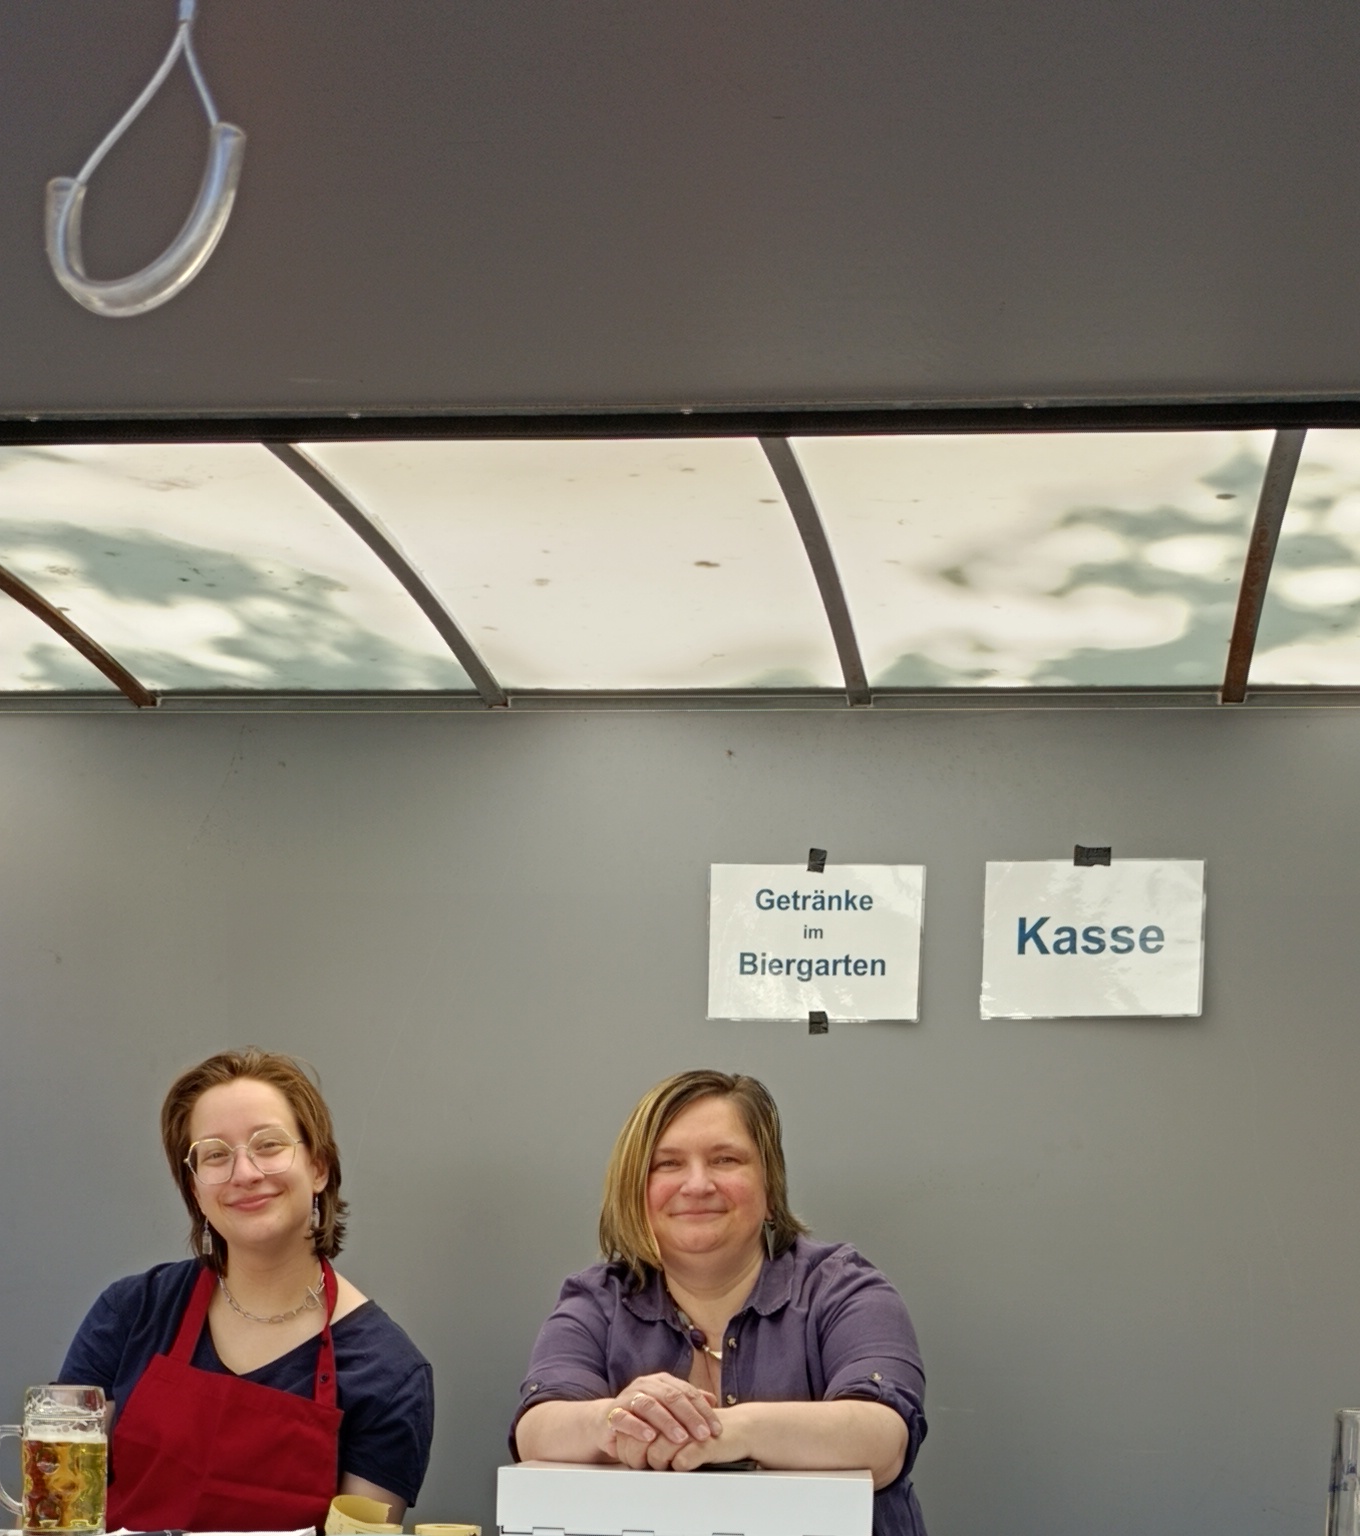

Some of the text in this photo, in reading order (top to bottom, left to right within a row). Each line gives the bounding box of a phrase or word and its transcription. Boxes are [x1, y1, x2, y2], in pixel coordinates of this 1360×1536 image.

[756, 889, 873, 911] Getränke
[804, 924, 823, 939] im
[1017, 917, 1165, 955] Kasse
[740, 952, 886, 982] Biergarten
